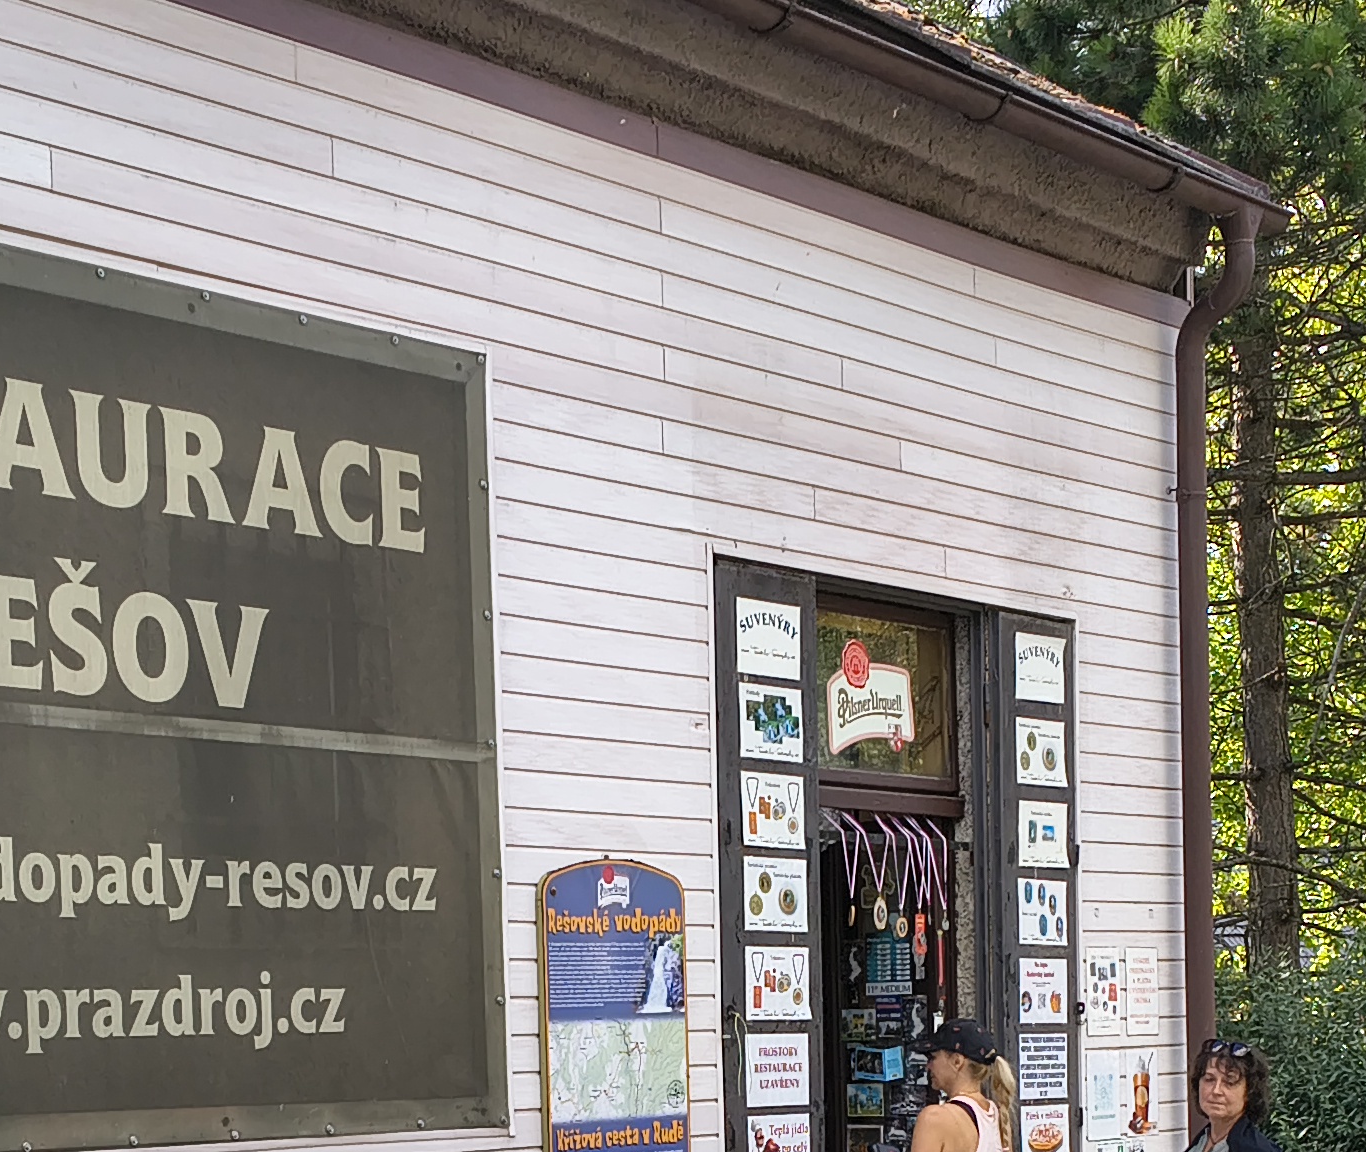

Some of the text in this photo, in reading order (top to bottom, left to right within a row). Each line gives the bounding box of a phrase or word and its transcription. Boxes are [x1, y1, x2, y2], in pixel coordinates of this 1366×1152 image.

[739, 612, 799, 640] SUVENÝRY
[1018, 645, 1061, 668] SUVENÝRY
[837, 687, 902, 728] Pilsner Urquell
[614, 907, 682, 940] vodopády
[754, 1062, 803, 1074] RESTAURACE
[556, 1119, 684, 1152] Křížová cesta v Rudě
